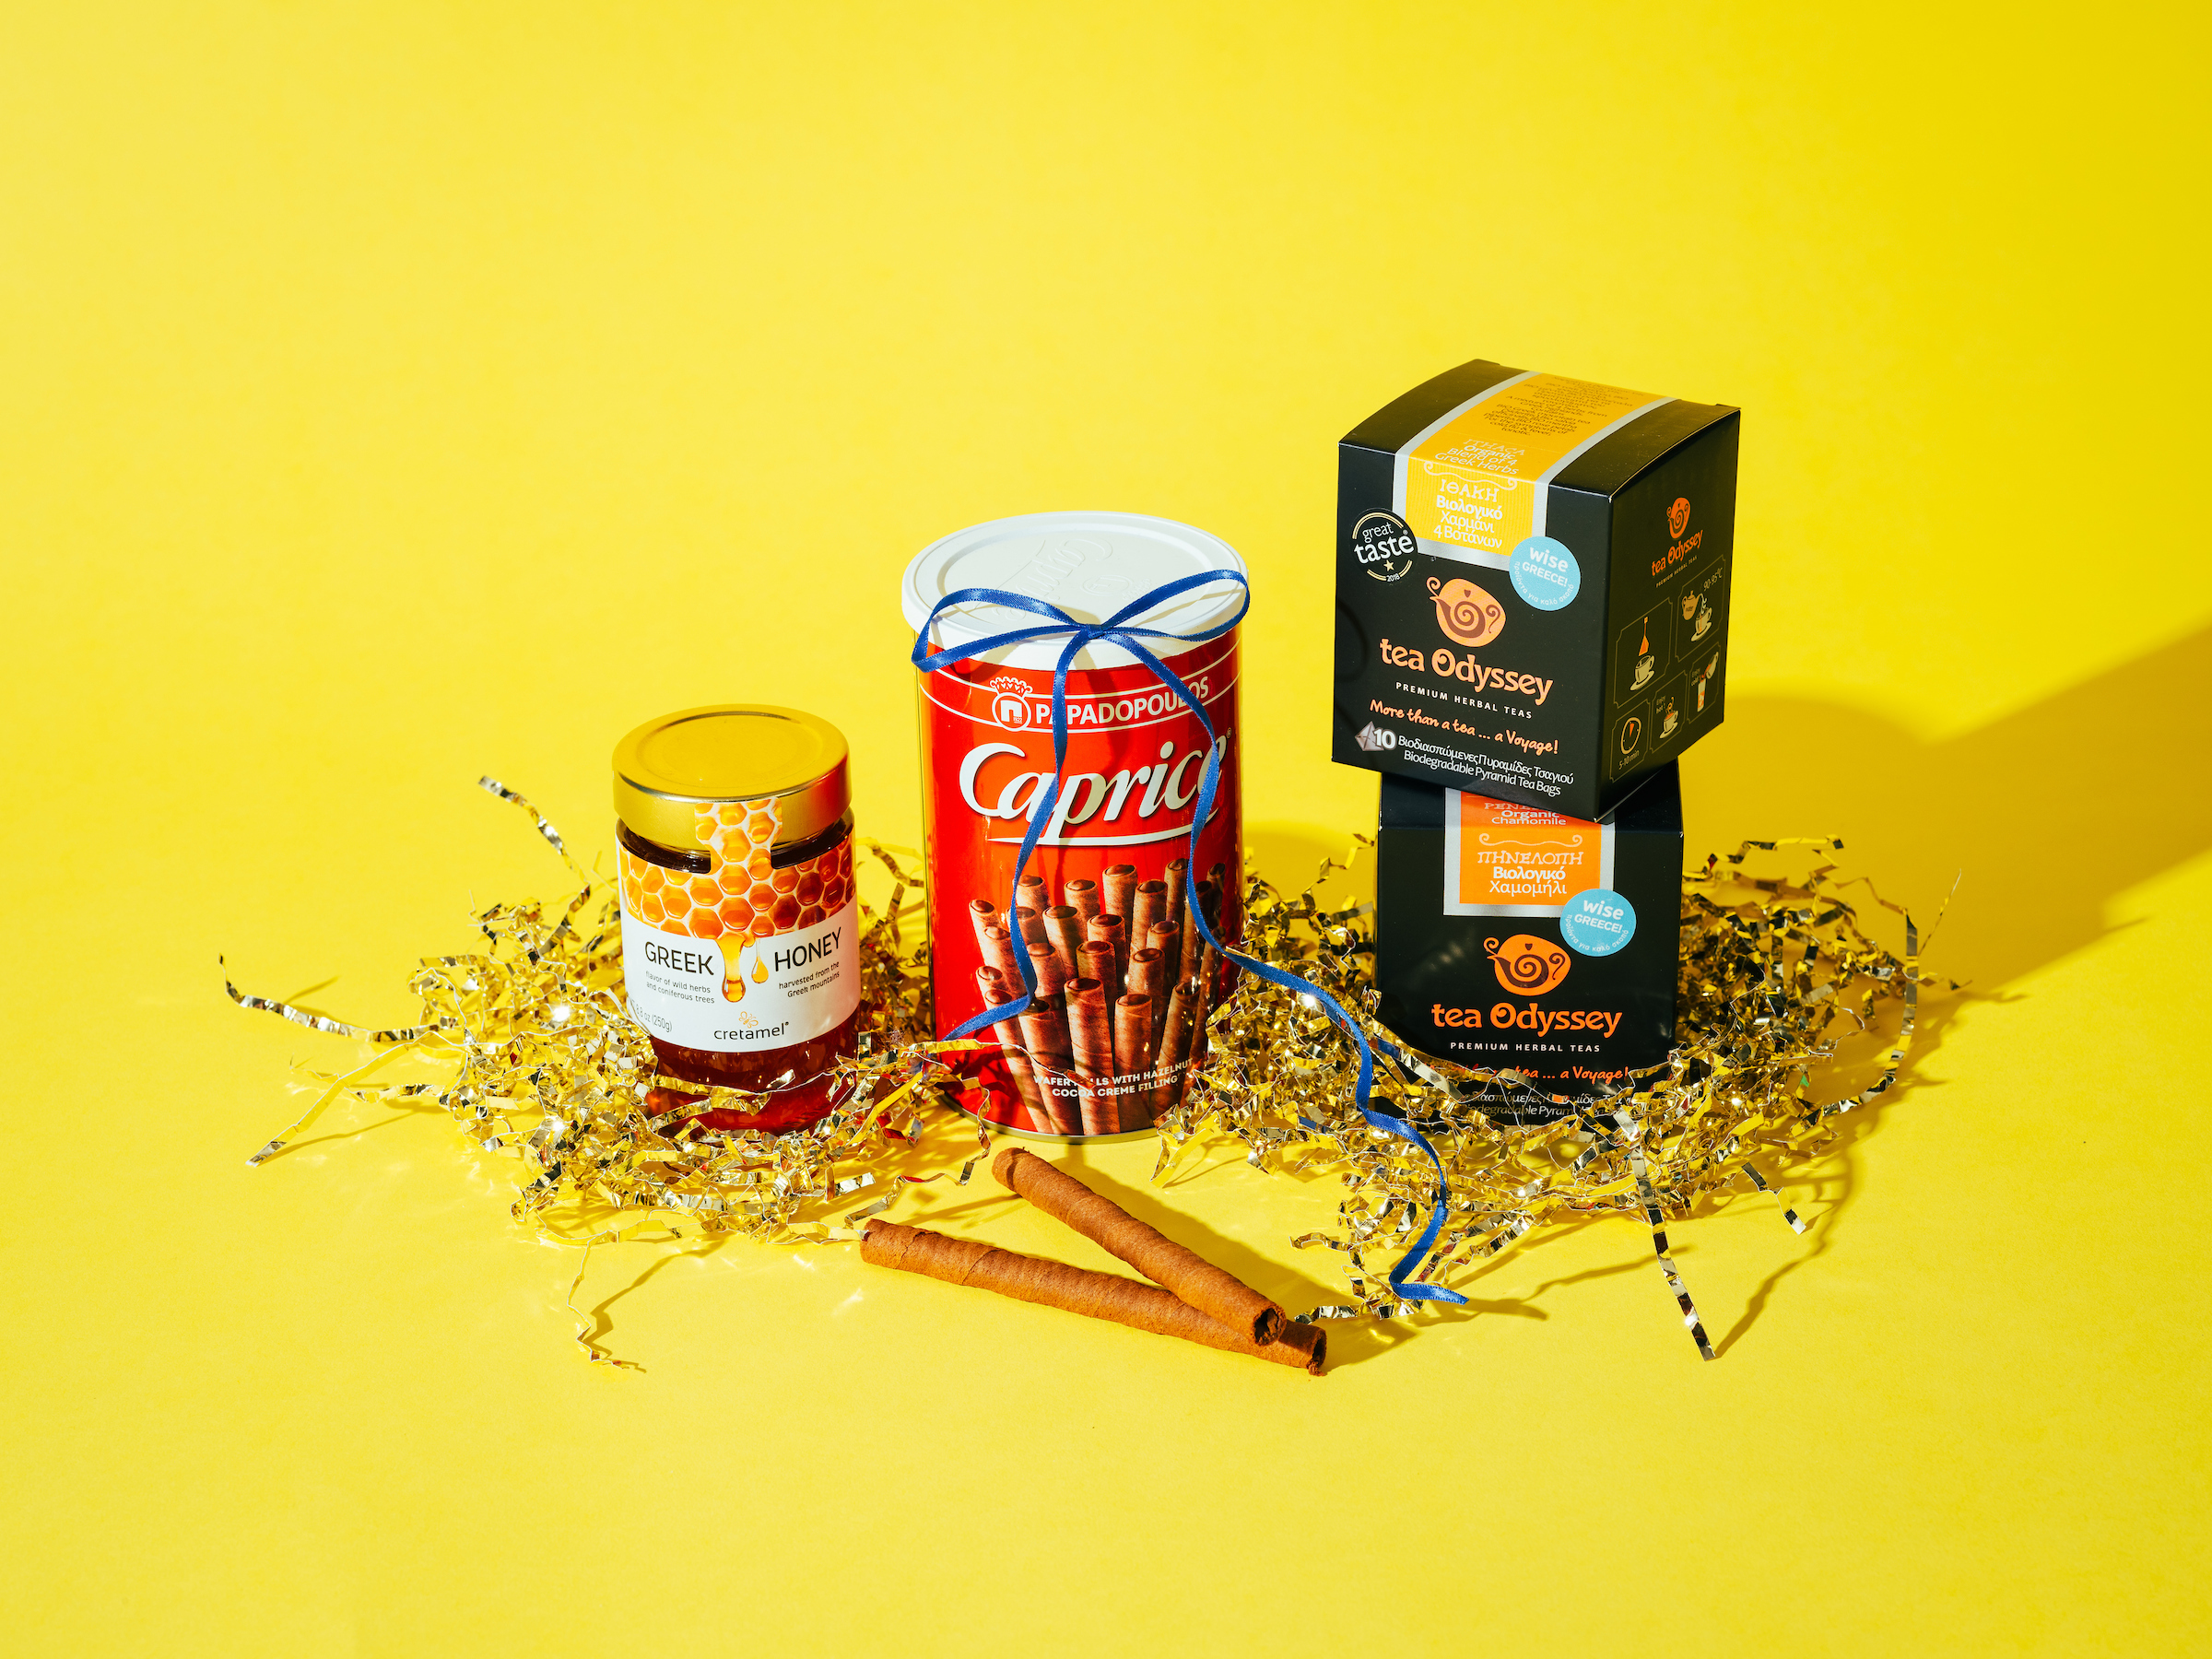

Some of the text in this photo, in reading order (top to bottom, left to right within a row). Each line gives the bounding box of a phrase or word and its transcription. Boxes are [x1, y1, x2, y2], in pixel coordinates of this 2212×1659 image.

[1447, 448, 1487, 462] Blend
[1488, 453, 1505, 465] of
[1463, 439, 1525, 455] ITHACA
[1464, 445, 1515, 459] Organic
[1435, 453, 1519, 475] Greek Herbs
[1436, 495, 1502, 520] Βιολογικό
[1362, 522, 1394, 543] great
[1441, 511, 1495, 534] Χαρμάνι
[1433, 524, 1502, 548] 4 Βοτάνων
[1354, 535, 1414, 564] taste
[1530, 547, 1569, 572] wise
[1651, 529, 1703, 576] tea Odyssey
[1385, 573, 1400, 582] 2018
[1522, 561, 1568, 587] GREECE!
[1527, 593, 1539, 603] για
[1380, 638, 1554, 706] tea Odyssey
[1036, 676, 1209, 725] PPADOPOULOS
[1395, 681, 1533, 719] PREMIUM HERBAL TEAS
[1370, 699, 1406, 719] More
[1406, 708, 1440, 728] than
[1441, 720, 1451, 730] a
[1453, 718, 1476, 736] tea
[1494, 732, 1503, 743] a
[1505, 729, 1559, 756] Voyage!
[1373, 727, 1396, 750] 10
[1404, 749, 1561, 797] Biodegradable Pyramid Tea Bags
[1478, 753, 1532, 778] Πυραμίδες
[1534, 766, 1574, 785] Τσαγιού
[1491, 817, 1567, 825] Chamomile
[1500, 810, 1559, 819] Organic
[1493, 865, 1566, 883] Βιολογικό
[1489, 879, 1567, 898] Χαμομήλι
[1583, 900, 1624, 920] wise
[1574, 913, 1622, 934] GREECE!
[645, 926, 841, 975] GREEK HONEY
[1578, 942, 1590, 950] για
[1592, 944, 1610, 952] καλό
[1611, 929, 1629, 947] σκοπό
[646, 971, 662, 983] flavor
[672, 980, 688, 990] wild
[689, 983, 711, 994] herbs
[779, 961, 840, 989] harvested from the
[787, 971, 840, 998] Greek mountains
[646, 981, 715, 1004] and coniferous trees
[644, 1012, 651, 1023] oz
[652, 1014, 672, 1033] (250g)
[713, 1022, 784, 1041] cretamel
[1430, 1002, 1623, 1039] tea Odyssey
[1450, 1041, 1600, 1053] PREMIUM HERBAL TEAS
[1033, 1076, 1071, 1086] WAFER
[1112, 1073, 1141, 1085] WITH
[1143, 1058, 1194, 1080] HAZELNUT
[1559, 1070, 1570, 1078] a
[1572, 1065, 1629, 1086] Voyage!
[1052, 1076, 1178, 1098] COCOA CREME FILLING
